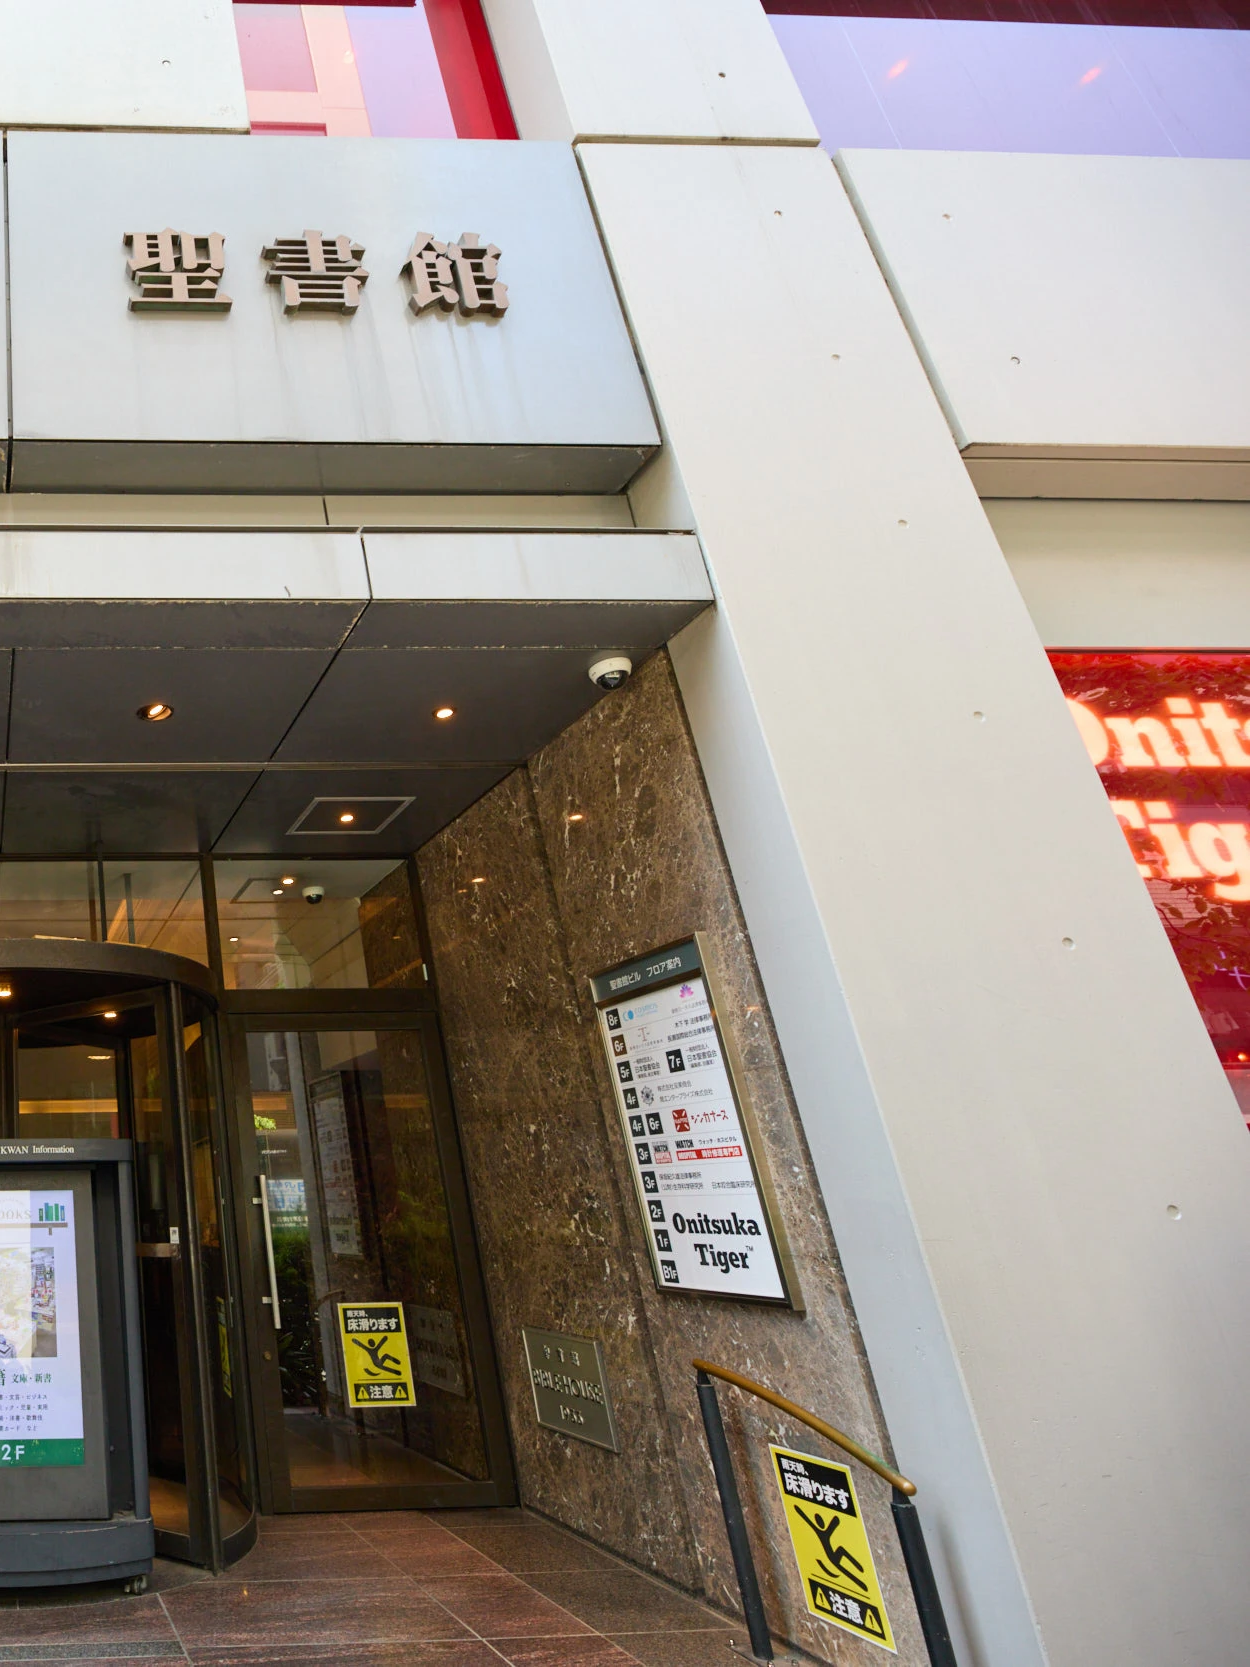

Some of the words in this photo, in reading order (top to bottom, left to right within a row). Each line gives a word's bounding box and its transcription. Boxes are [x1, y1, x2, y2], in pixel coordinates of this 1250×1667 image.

[123, 227, 509, 317] 聖書館
[1065, 698, 1250, 767] nit
[609, 971, 642, 991] 聖書館ビル
[645, 956, 682, 977] フロア案内
[608, 1014, 619, 1027] 8F
[614, 1040, 624, 1052] 6F
[668, 1055, 681, 1069] 7F
[620, 1066, 630, 1078] 5F
[626, 1093, 636, 1105] 4F
[691, 1109, 729, 1124] シンカナース
[632, 1121, 643, 1132] 4F
[649, 1118, 660, 1130] 6F
[32, 1144, 75, 1154] Information
[675, 1139, 694, 1149] WATCH
[638, 1148, 649, 1160] 3F
[644, 1176, 656, 1189] 3F
[650, 1204, 662, 1218] 2F
[672, 1212, 761, 1236] Onitsuka
[657, 1234, 669, 1248] 1F
[693, 1243, 749, 1274] Tiger
[662, 1265, 678, 1280] B1F
[347, 1318, 398, 1331] 床滑ります
[12, 1373, 52, 1383] 文庫・新書
[370, 1385, 394, 1399] 注意
[532, 1368, 563, 1393] BIBLE
[563, 1375, 604, 1405] HOUSE
[1, 1443, 25, 1460] 2F
[784, 1472, 850, 1509] 床滑ります
[829, 1591, 864, 1625] 注意
